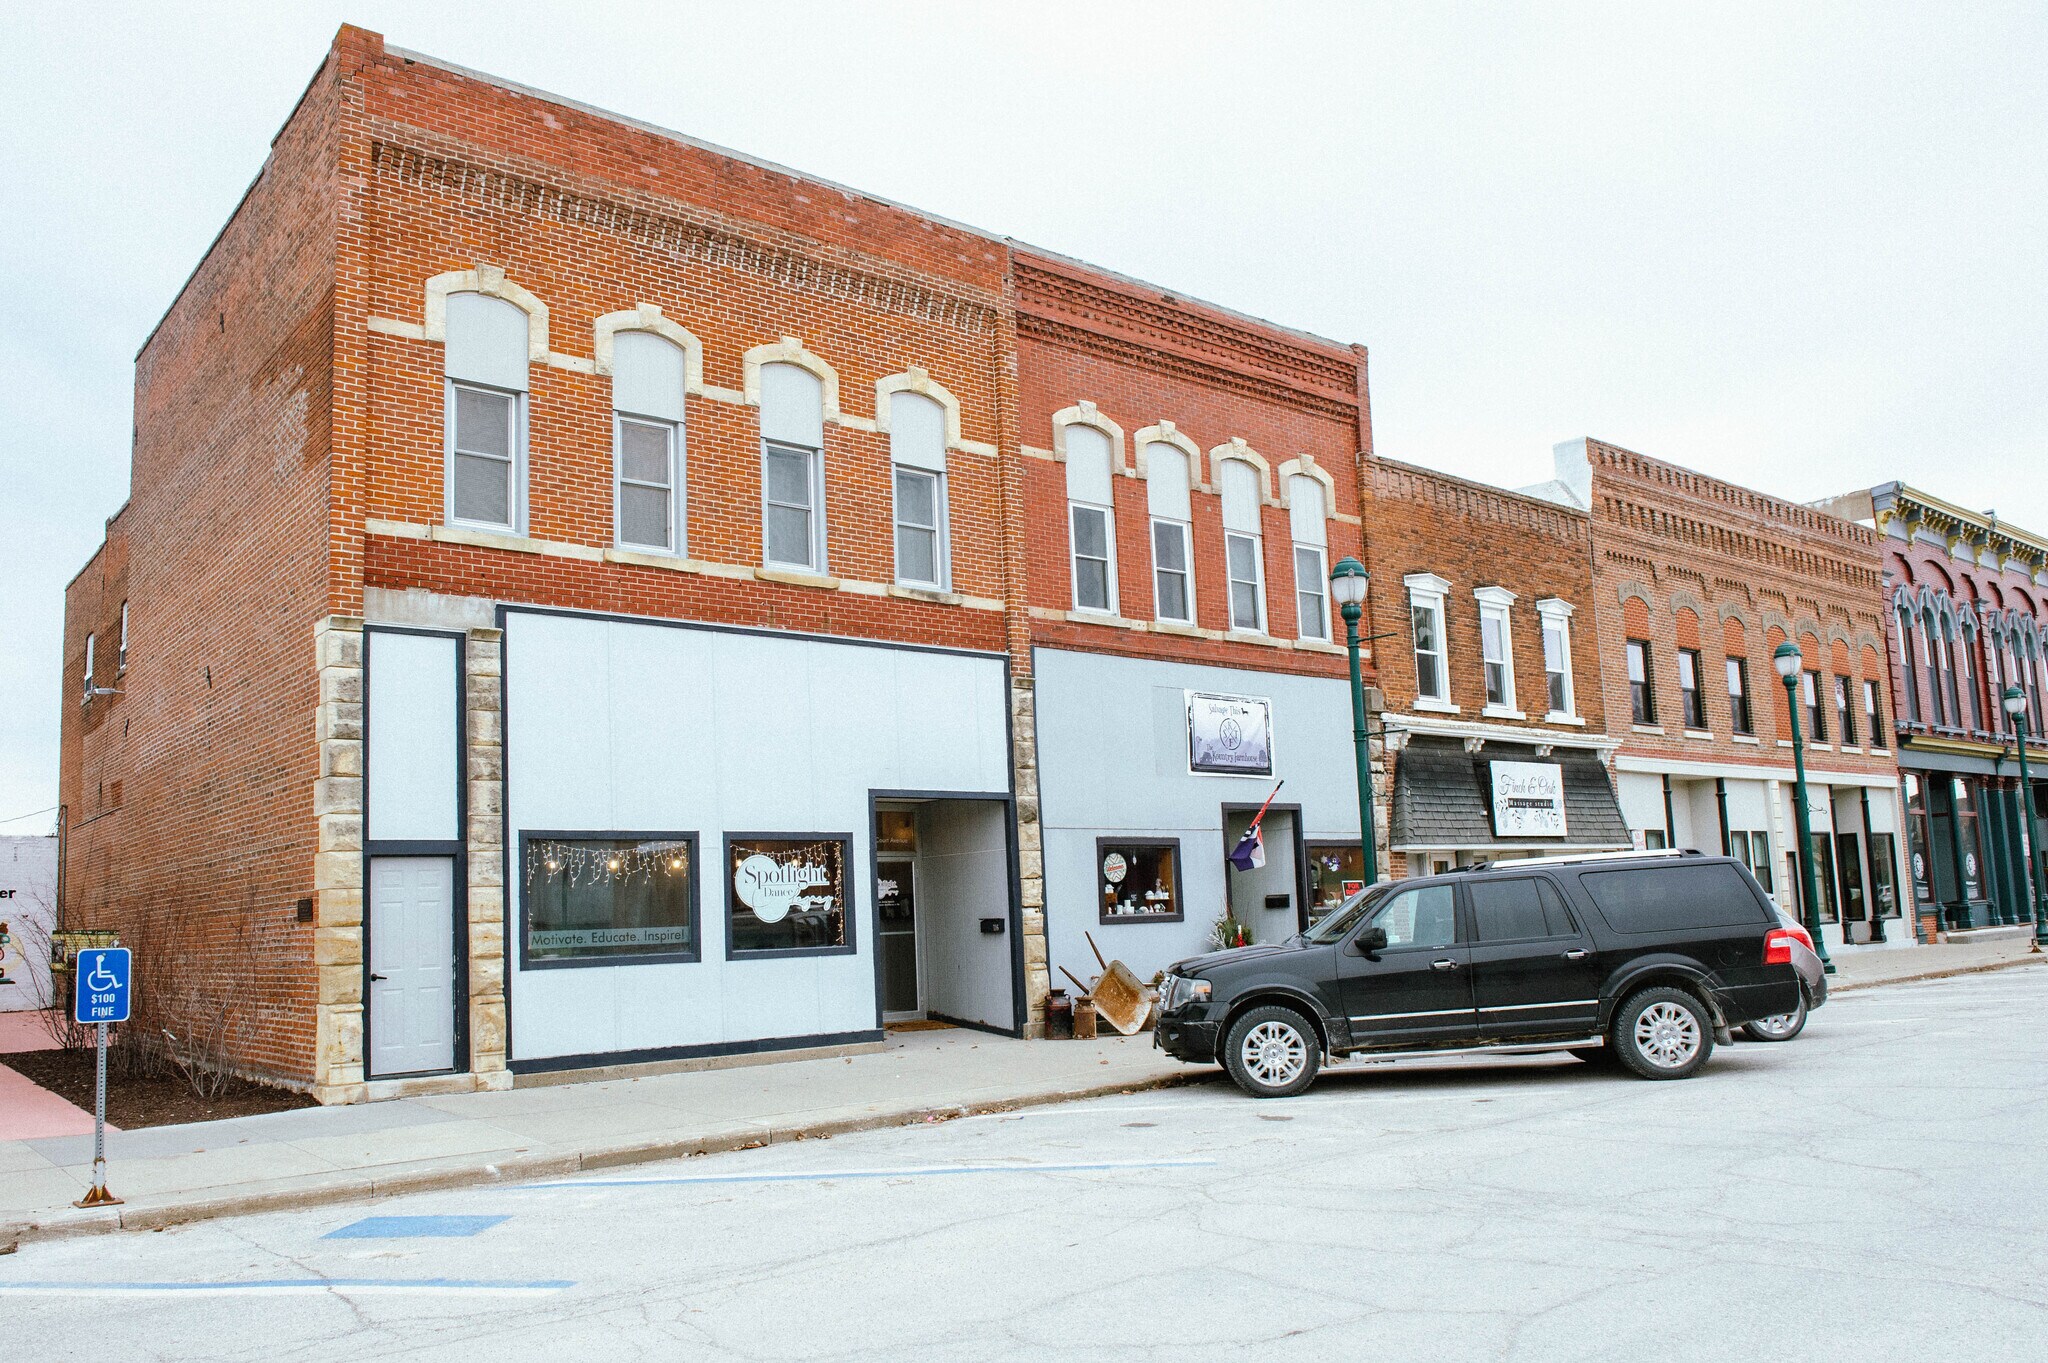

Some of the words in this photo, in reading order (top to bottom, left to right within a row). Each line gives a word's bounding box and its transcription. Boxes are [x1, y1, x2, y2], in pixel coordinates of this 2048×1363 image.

[1230, 705, 1241, 716] This
[1509, 800, 1532, 808] Massage
[744, 862, 826, 889] Spotlight
[763, 887, 794, 897] Dance
[531, 933, 587, 946] Motivate.
[591, 931, 640, 943] Educate.
[644, 929, 685, 942] Inspire!
[91, 993, 115, 1004] $100
[91, 1007, 114, 1017] FINE
